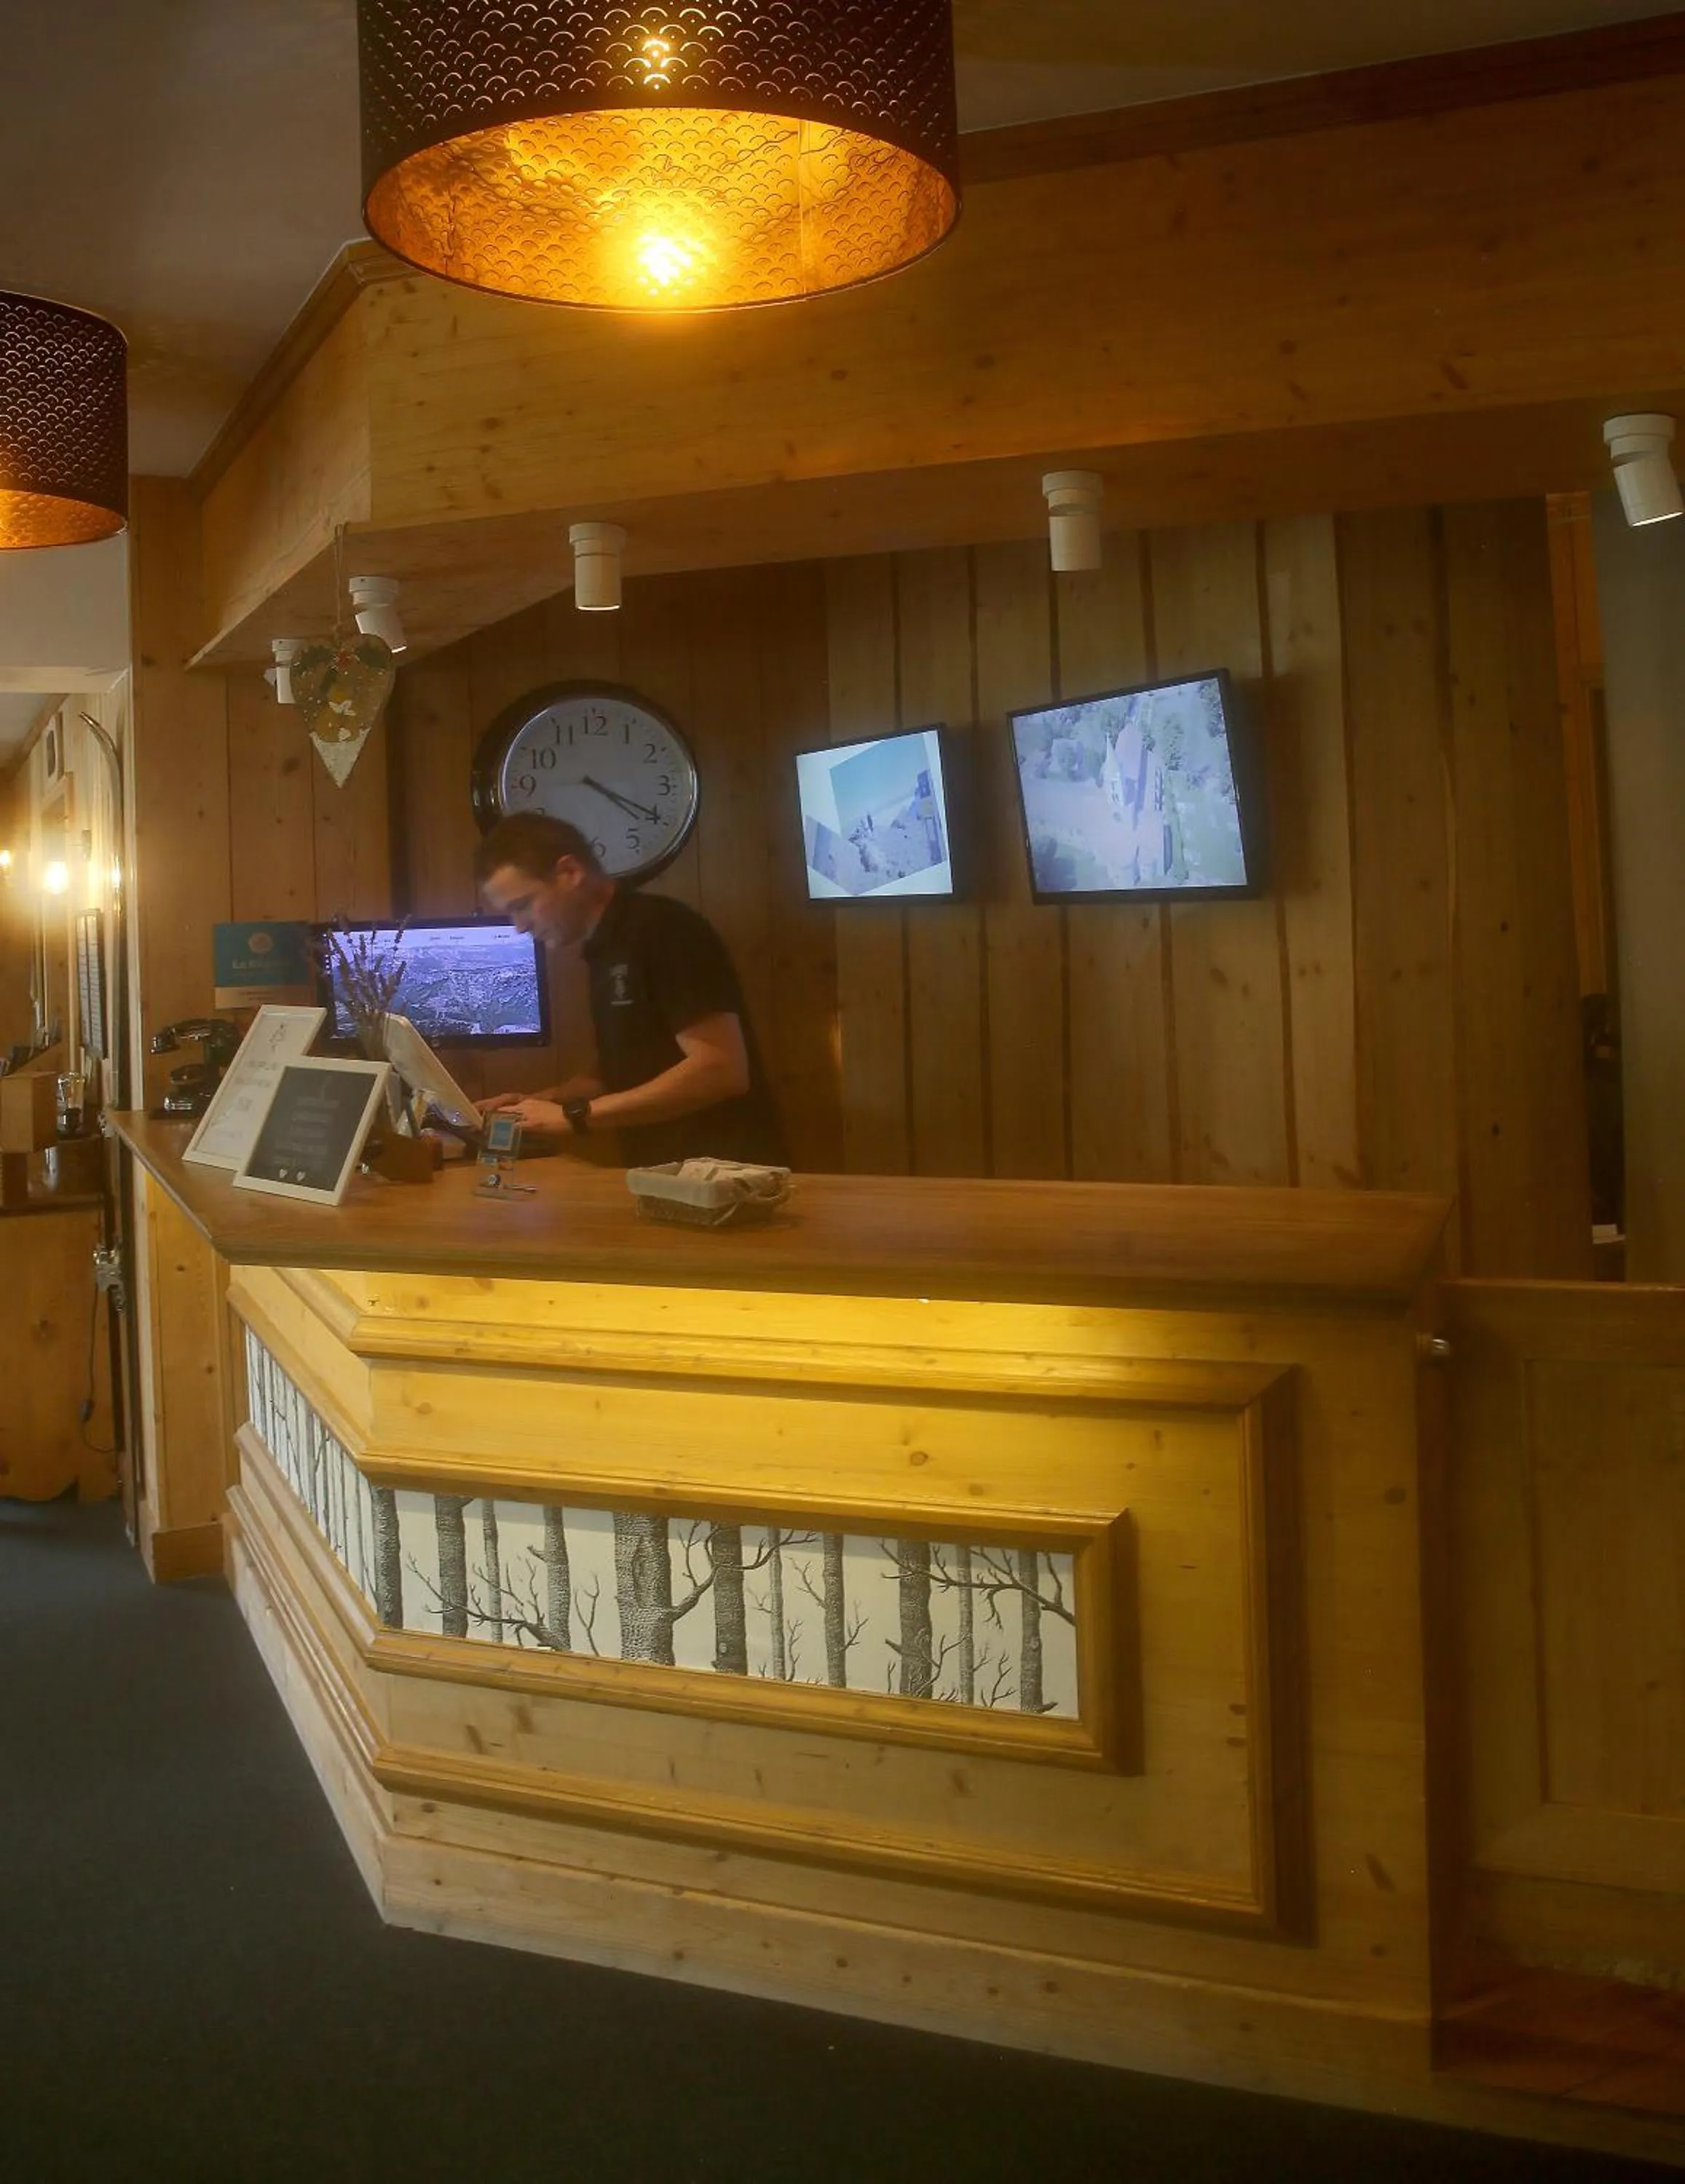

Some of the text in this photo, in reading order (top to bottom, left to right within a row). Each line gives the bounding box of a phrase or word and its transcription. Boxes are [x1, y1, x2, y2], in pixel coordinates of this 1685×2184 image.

[556, 724, 574, 745] 11
[583, 715, 608, 736] 12
[623, 723, 630, 745] 1
[532, 747, 557, 769] 10
[643, 743, 658, 764] 2
[519, 773, 537, 798] 9
[657, 775, 671, 796] 3
[644, 804, 660, 826] 4
[626, 828, 641, 850] 5
